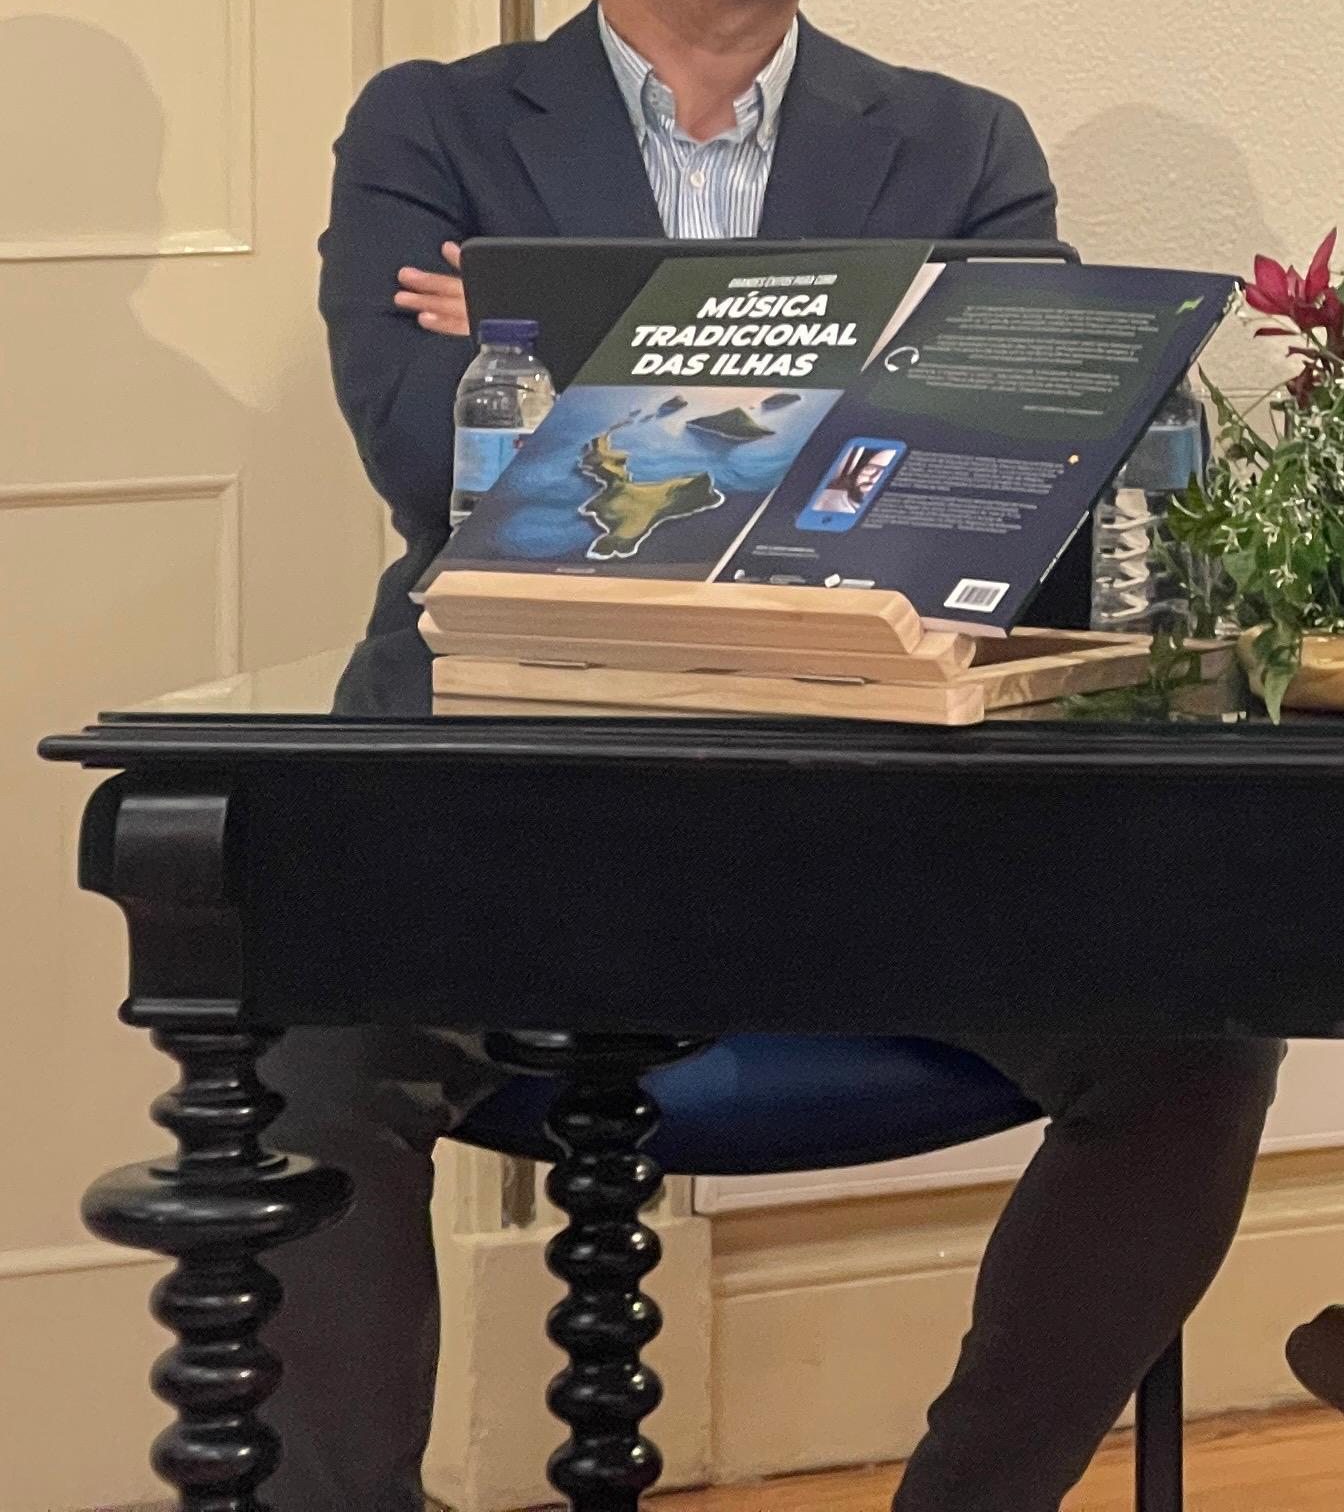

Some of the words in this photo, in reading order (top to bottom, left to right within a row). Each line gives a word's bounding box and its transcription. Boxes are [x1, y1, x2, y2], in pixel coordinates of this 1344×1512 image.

[696, 291, 829, 319] MÚSICA
[631, 322, 858, 348] TRADICIONAL
[631, 352, 711, 376] DAS
[709, 352, 819, 377] ILHAS
